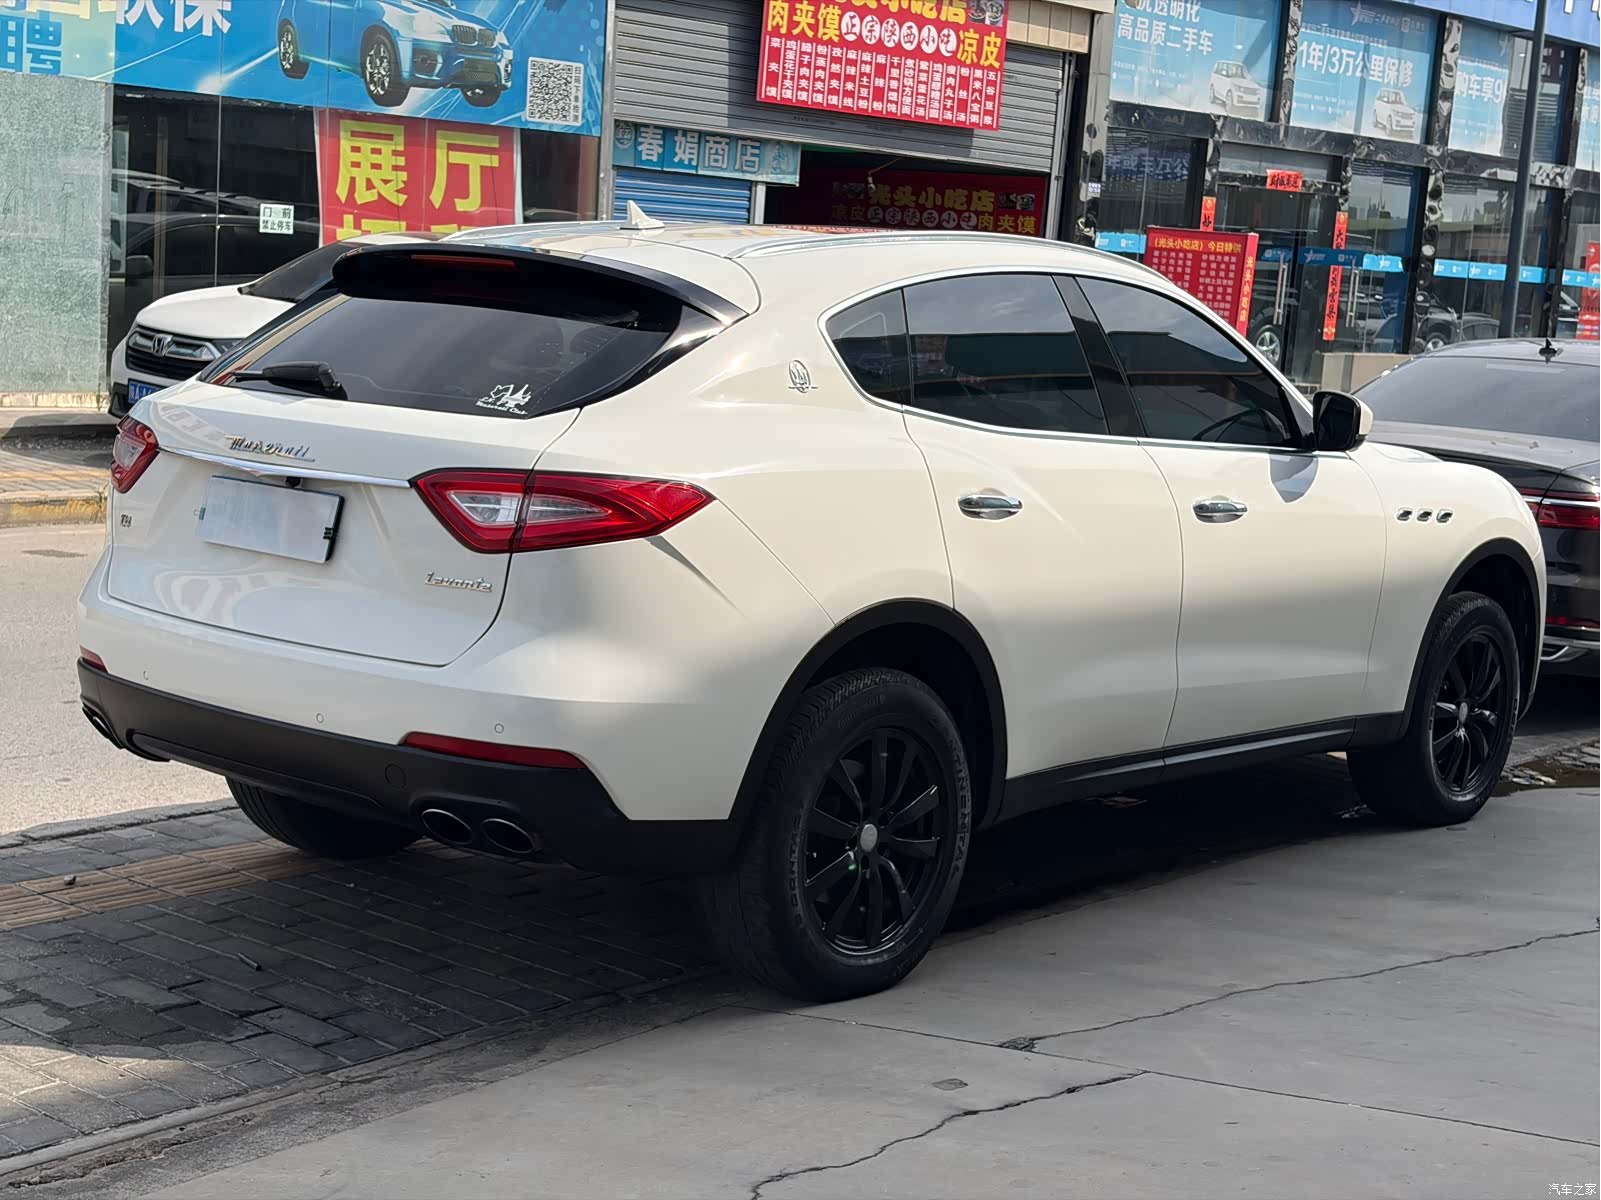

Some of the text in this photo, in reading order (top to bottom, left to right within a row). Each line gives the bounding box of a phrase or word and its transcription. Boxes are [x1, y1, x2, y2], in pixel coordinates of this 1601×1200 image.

[767, 1, 1002, 69] 肉夹馍 正宗陕西小吃 凉皮
[1117, 13, 1214, 55] 高品质二手车
[812, 44, 827, 103] 粉蒸肉夹馍
[843, 49, 857, 107] 麻辣米线
[857, 52, 872, 109] 麻辣土豆粉
[872, 54, 886, 111] 麻辣粉
[1298, 40, 1413, 87] 1年/3万公里保修
[956, 67, 970, 122] 粉丝汤
[983, 71, 997, 125] 五谷豆浆
[336, 119, 501, 212] 展厅
[637, 126, 761, 173] 春娟商店
[262, 206, 292, 219] 门前
[869, 184, 996, 212] 光头小吃店
[262, 219, 292, 231] 禁止停车
[978, 214, 1037, 235] 肉夹馍
[224, 434, 316, 463] Maserati
[424, 571, 493, 592] Levante
